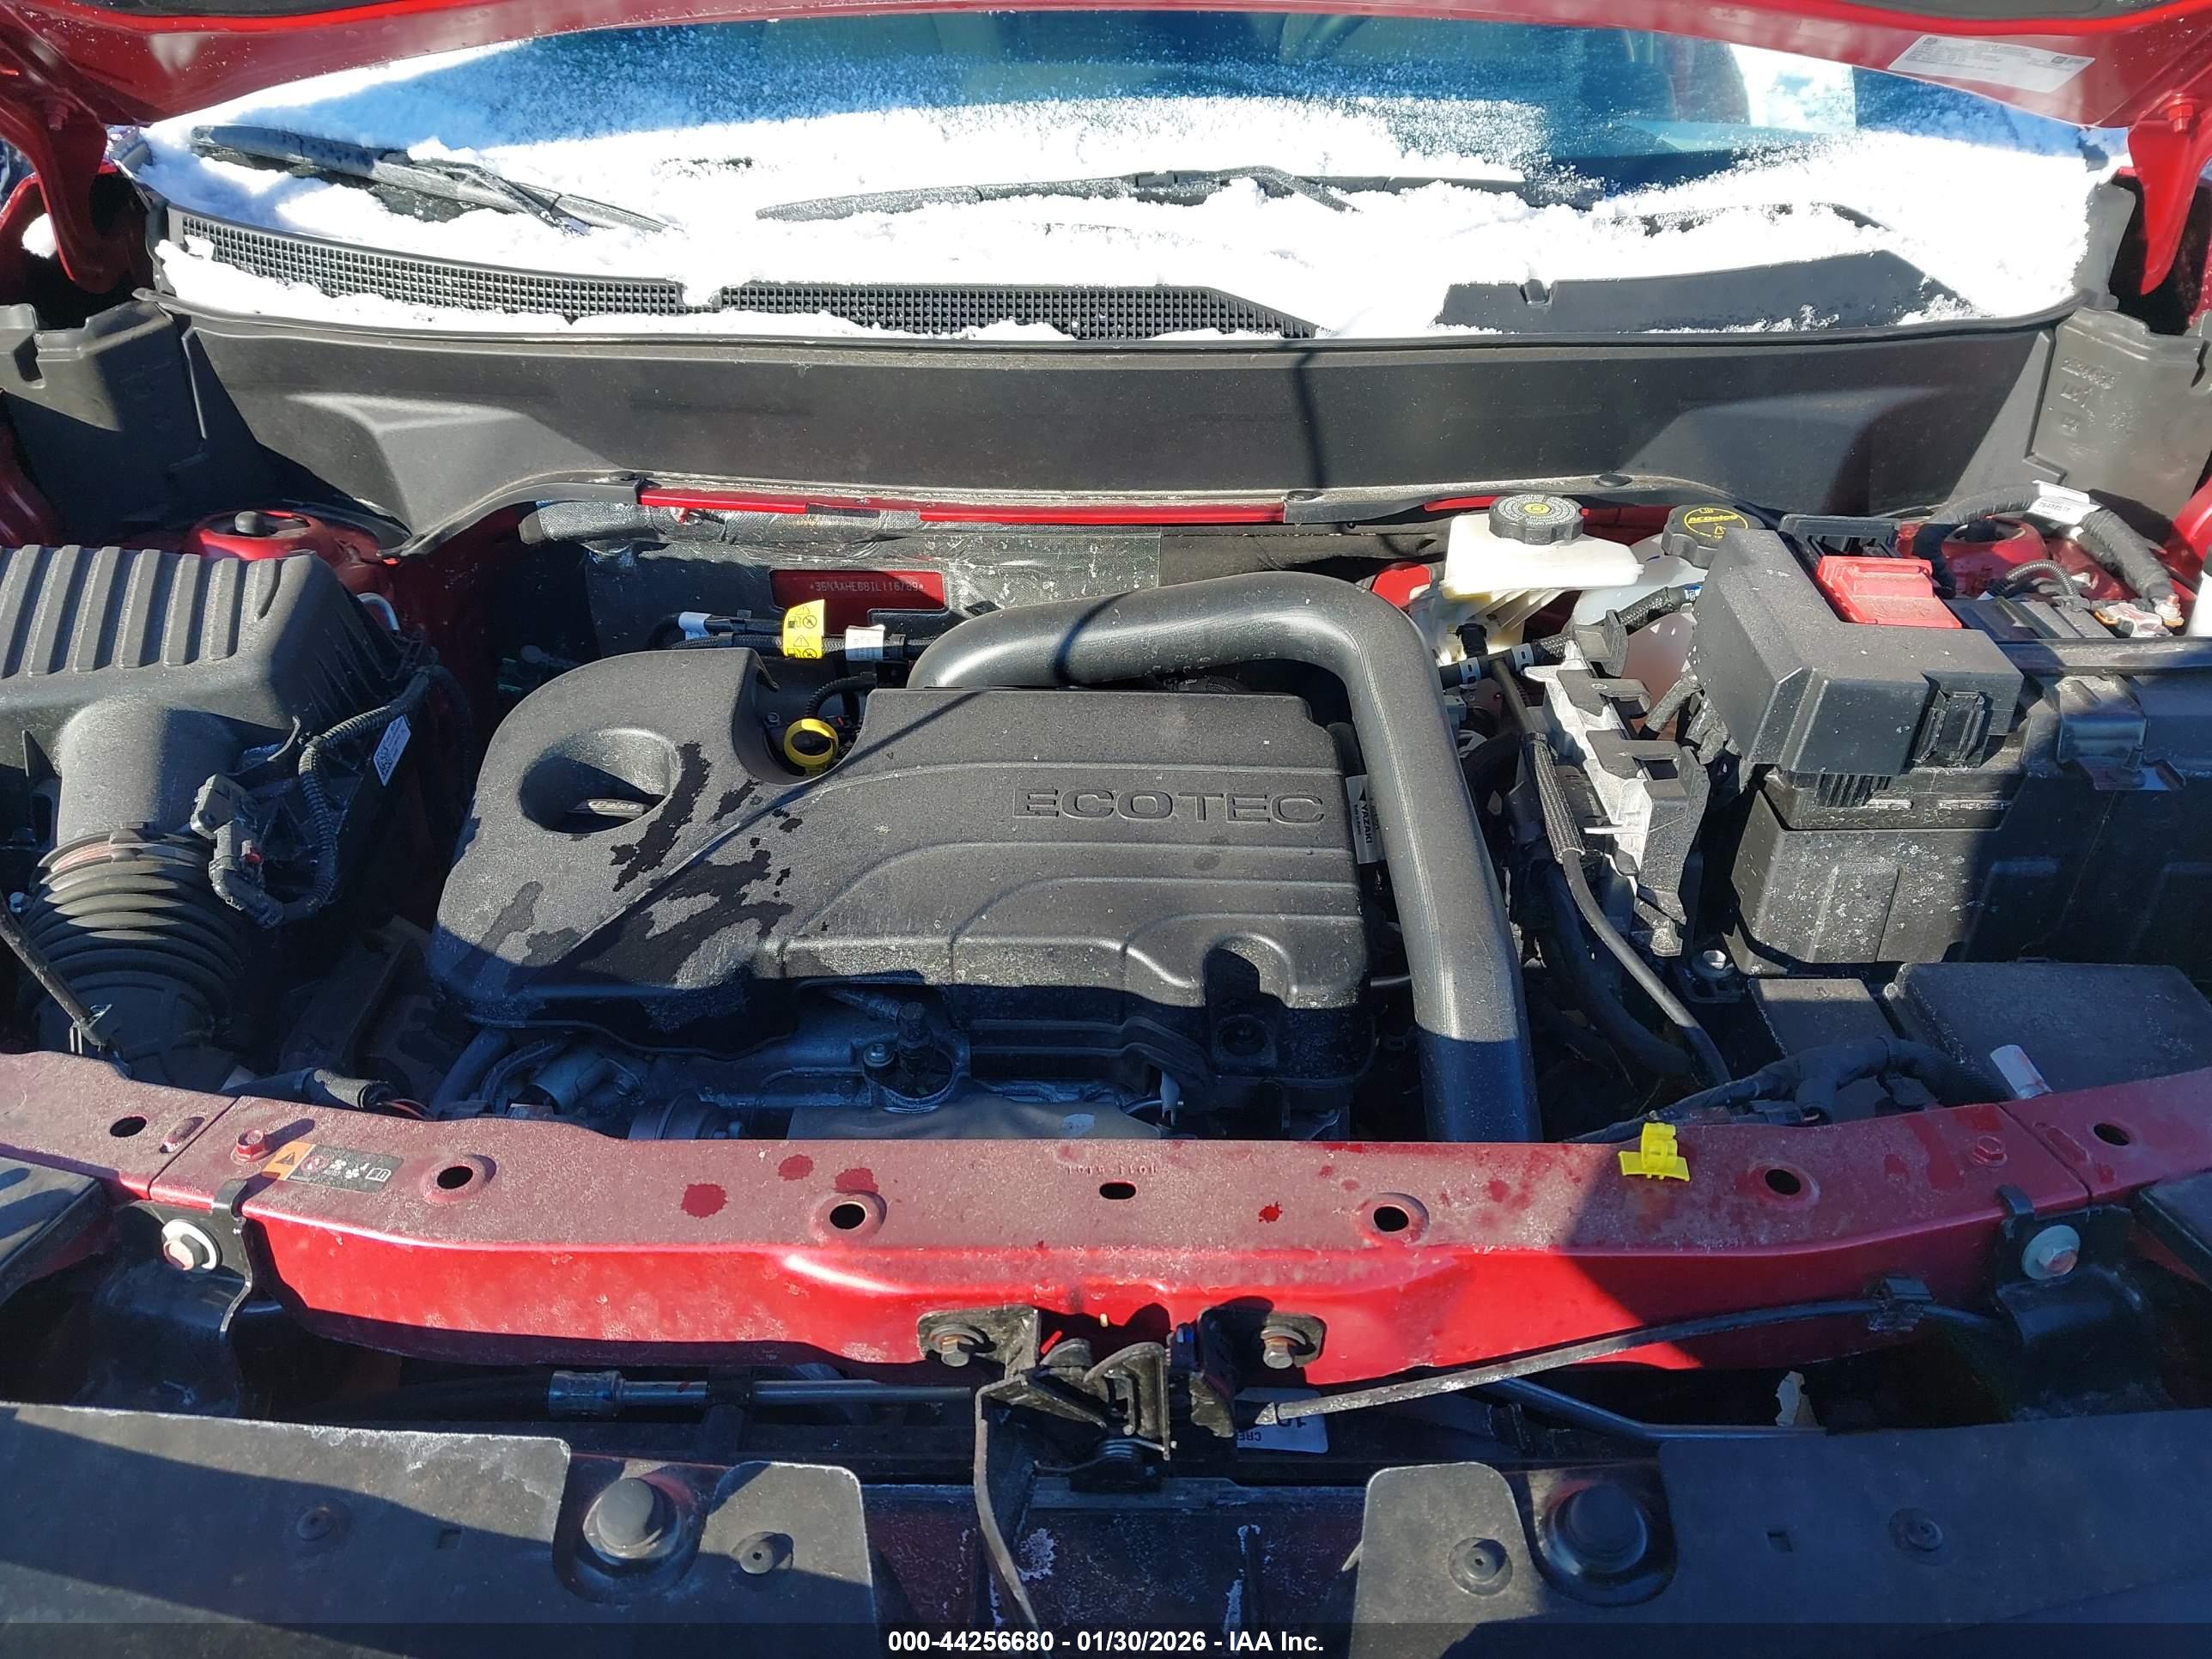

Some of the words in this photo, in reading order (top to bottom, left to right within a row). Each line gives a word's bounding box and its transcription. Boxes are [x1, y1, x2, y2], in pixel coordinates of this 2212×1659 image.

[1013, 788, 1324, 824] ECOTEC
[1361, 804, 1372, 844] YAZAKI
[1237, 1431, 1261, 1441] CRE
